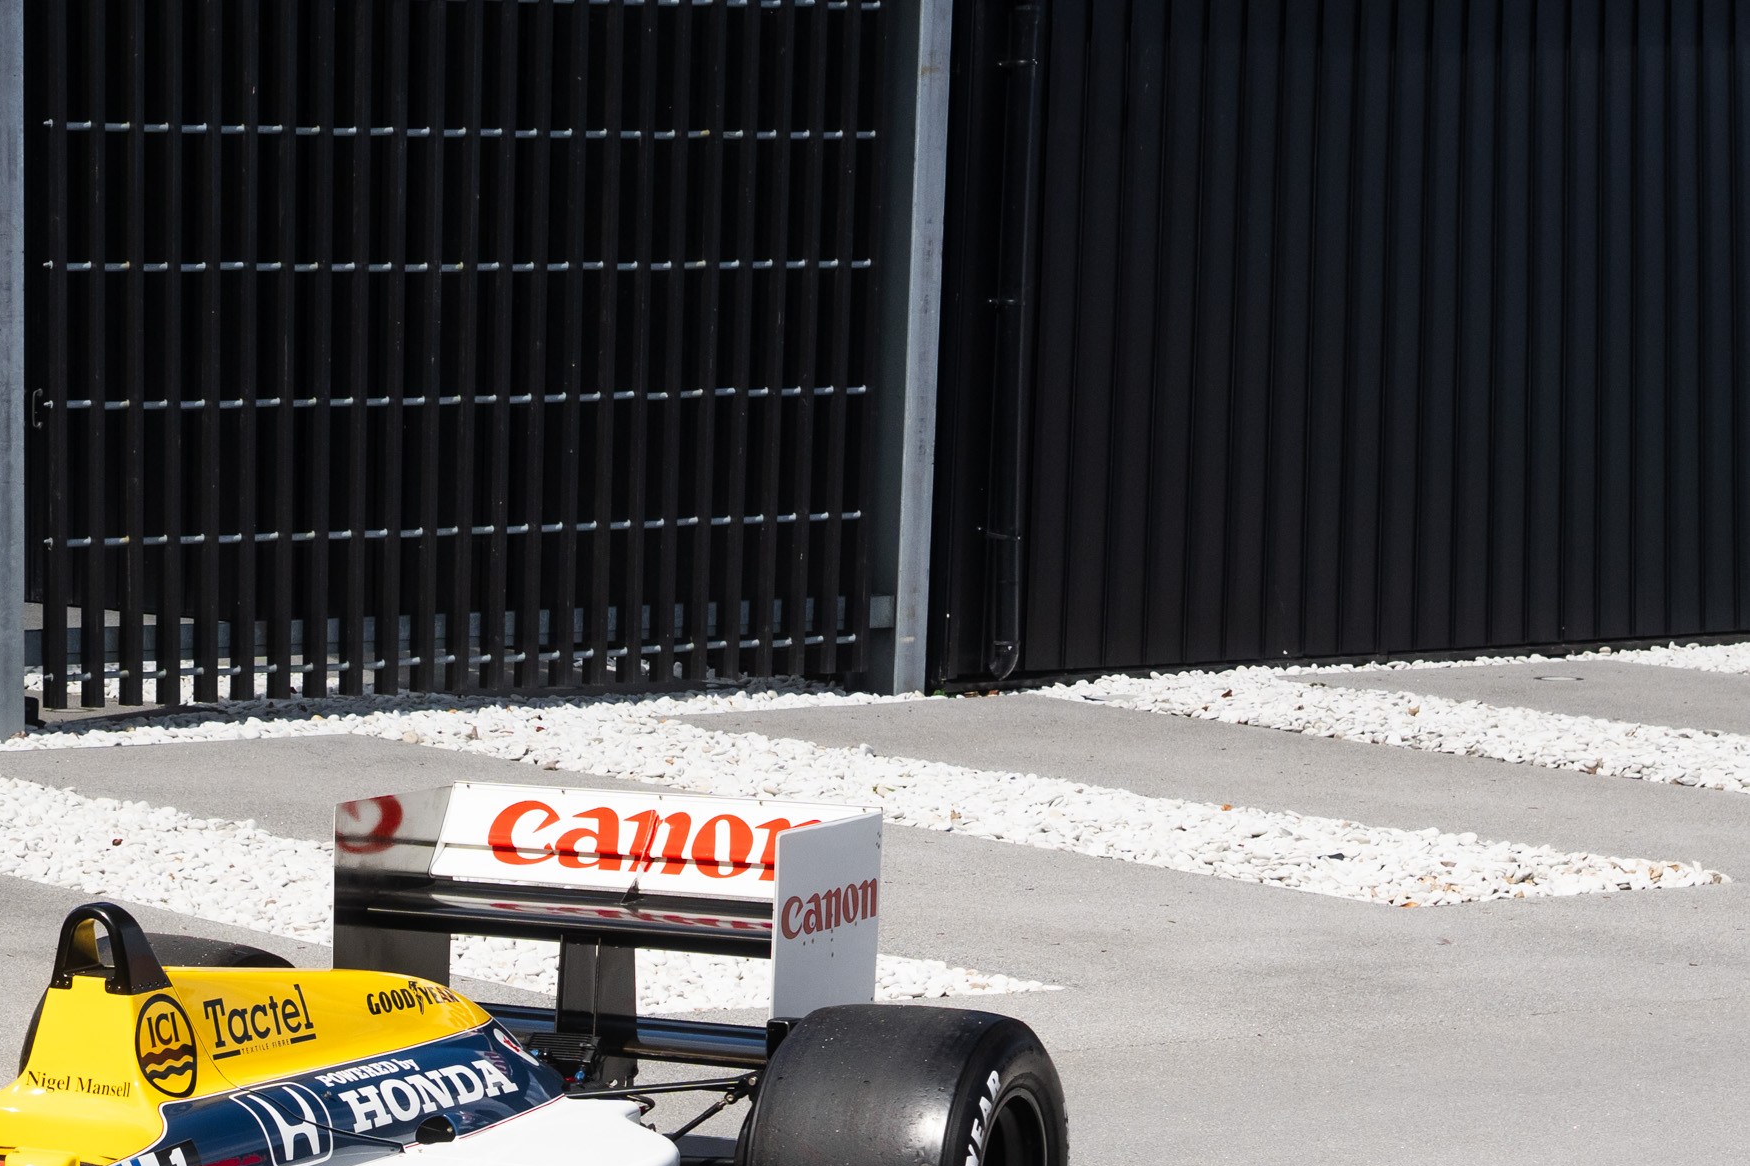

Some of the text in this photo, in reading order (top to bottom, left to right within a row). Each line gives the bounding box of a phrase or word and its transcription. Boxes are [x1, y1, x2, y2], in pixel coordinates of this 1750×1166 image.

[780, 877, 878, 940] Canon
[146, 1011, 181, 1049] ICI
[203, 984, 314, 1049] Tactel
[242, 1038, 290, 1055] TEXTILE FIBRE
[25, 1070, 131, 1098] Nigel Mansell
[315, 1058, 420, 1089] POWERED by
[337, 1060, 519, 1134] HONDA
